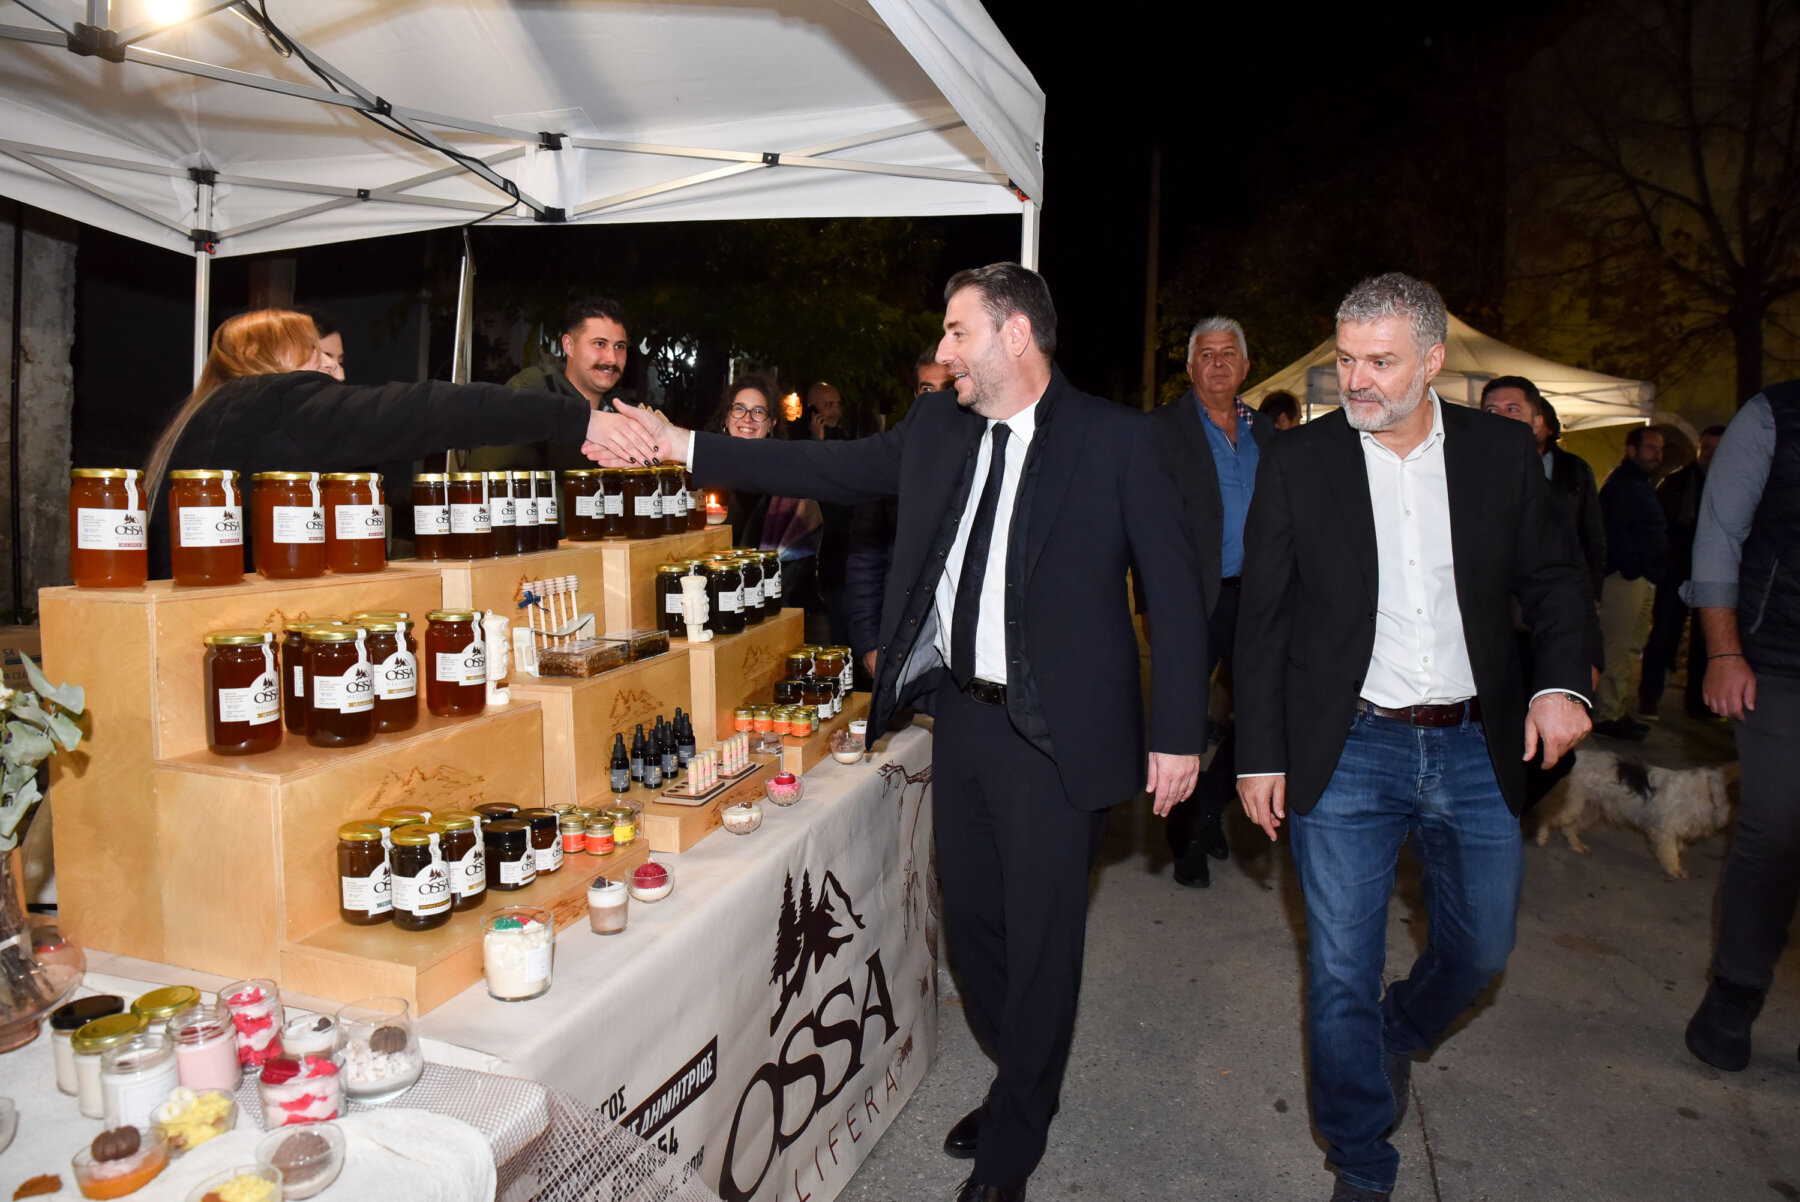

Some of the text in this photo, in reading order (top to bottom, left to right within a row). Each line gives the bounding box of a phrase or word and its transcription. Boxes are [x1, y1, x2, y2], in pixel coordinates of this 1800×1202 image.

[115, 525, 143, 536] OSSA
[385, 667, 414, 681] OSSA
[418, 877, 450, 895] OSSA
[640, 1049, 715, 1136] ΔΗΜΗΤΡΙΟΣ
[719, 948, 900, 1202] OSSA
[775, 1066, 899, 1202] LIFERA
